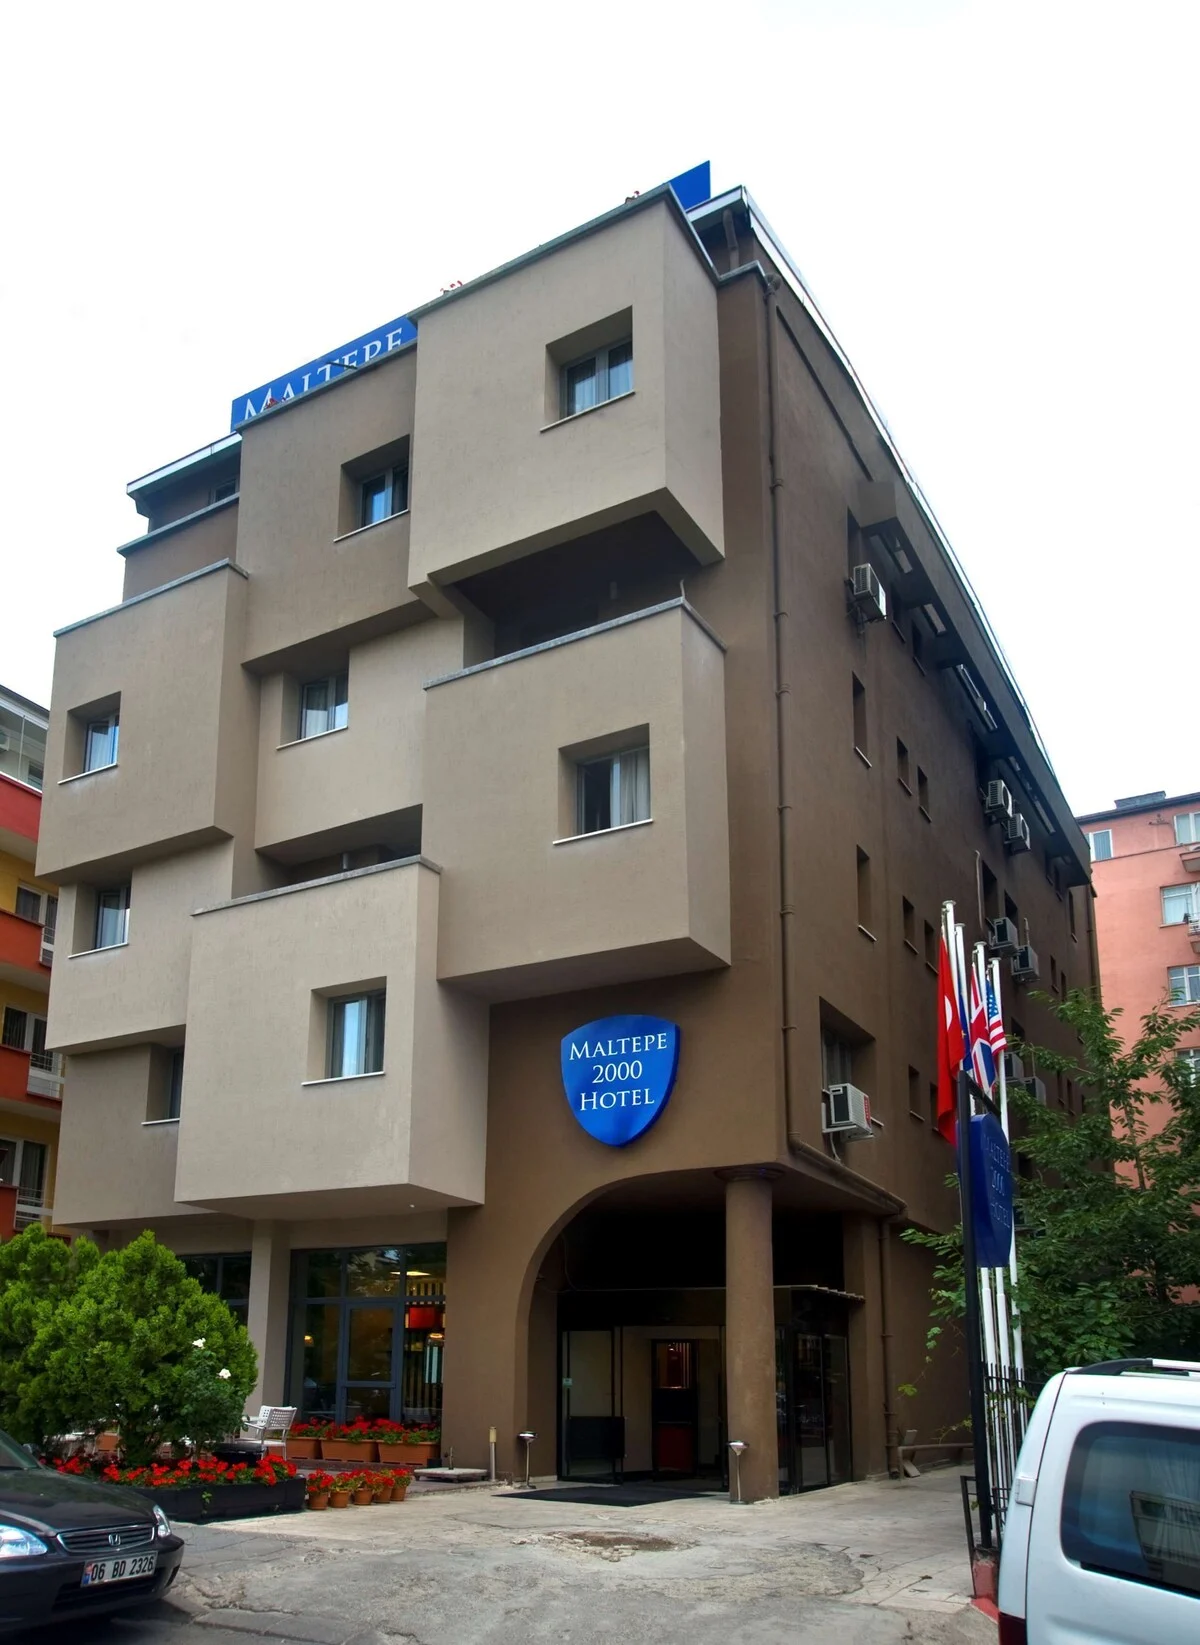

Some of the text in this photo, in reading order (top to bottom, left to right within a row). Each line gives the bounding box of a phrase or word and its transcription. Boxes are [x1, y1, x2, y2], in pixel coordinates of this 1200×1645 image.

[569, 1033, 667, 1060] MALTEPE
[592, 1060, 643, 1083] 2000
[580, 1088, 655, 1111] HOTEL
[91, 1556, 155, 1581] 06 BD 2326
